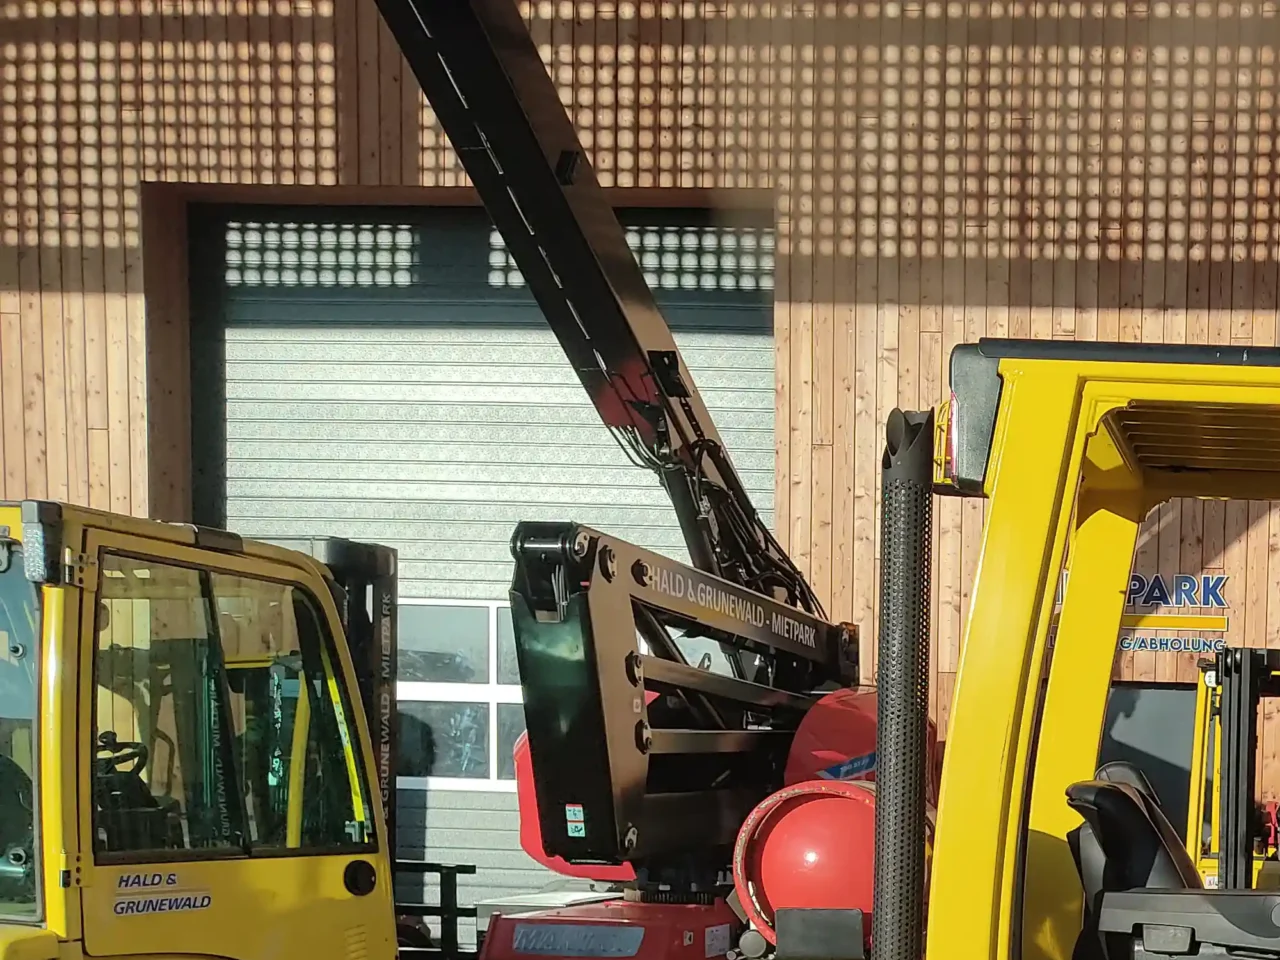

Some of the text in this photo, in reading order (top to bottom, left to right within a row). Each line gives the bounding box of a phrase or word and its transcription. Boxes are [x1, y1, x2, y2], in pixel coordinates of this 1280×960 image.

[651, 566, 685, 599] HALD
[687, 580, 697, 604] &
[697, 582, 765, 629] GRUNEWALD
[771, 611, 817, 649] MIETPARK
[1125, 572, 1229, 609] PARK
[381, 592, 391, 679] MIETPARK
[1119, 636, 1227, 653] G/ABHOLUNG
[380, 692, 390, 801] GRUNEWALD
[118, 873, 177, 888] HALD &
[113, 895, 212, 915] GRUNEWALD
